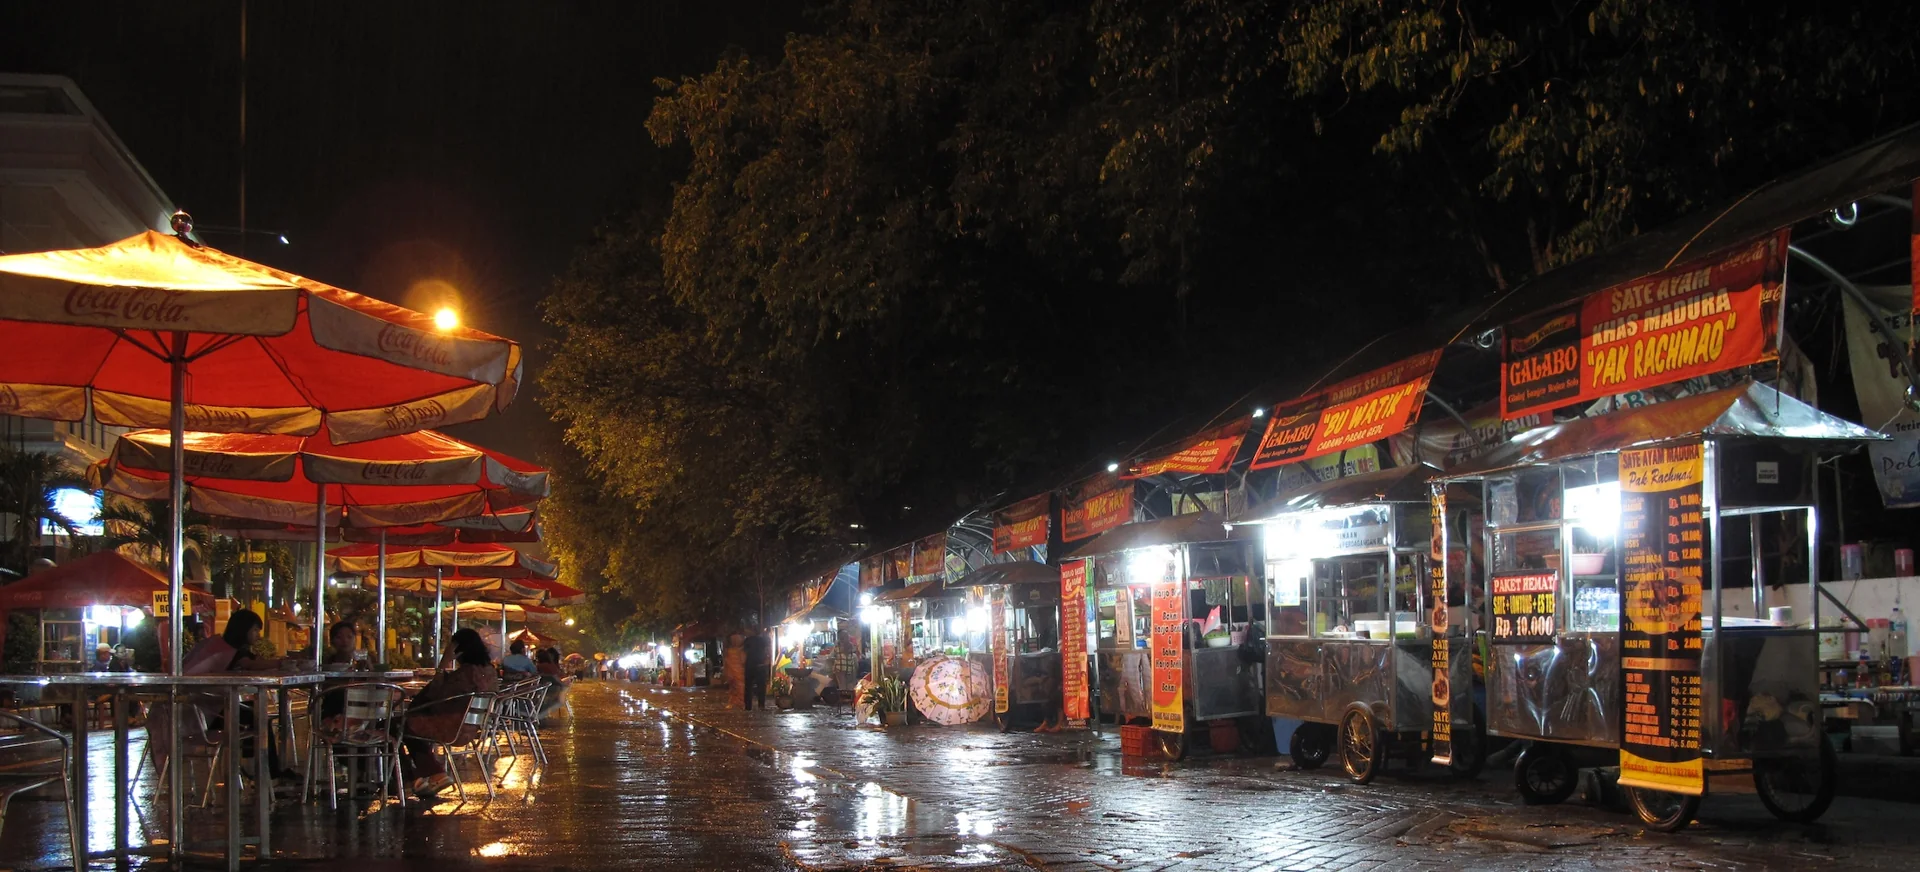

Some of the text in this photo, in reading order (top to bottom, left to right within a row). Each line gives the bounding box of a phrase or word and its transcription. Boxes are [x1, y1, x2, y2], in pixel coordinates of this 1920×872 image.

[1612, 267, 1711, 314] SATE AYAM
[1592, 313, 1639, 346] KHAS
[1643, 288, 1731, 333] MADURA
[1510, 346, 1578, 386] GALABO
[1266, 423, 1315, 448] GALABO
[1317, 436, 1343, 451] CABANG
[1343, 430, 1366, 444] PASAR
[1623, 444, 1700, 469] SATE AYAM MADURA
[1629, 471, 1648, 487] Pak
[1494, 576, 1554, 592] PAKET HEMAT
[1495, 616, 1553, 638] Rp. 10.000
[1433, 640, 1448, 650] SATE
[1671, 676, 1681, 684] Rp.
[1671, 687, 1681, 695] Rp.
[1671, 697, 1681, 706] Rp.
[1433, 711, 1449, 722] SATE
[1671, 707, 1681, 717] Rp.
[1433, 723, 1450, 733] AYAM
[1671, 718, 1681, 727] Rp.
[1671, 728, 1681, 738] Rp.
[1671, 739, 1680, 749] Rp.
